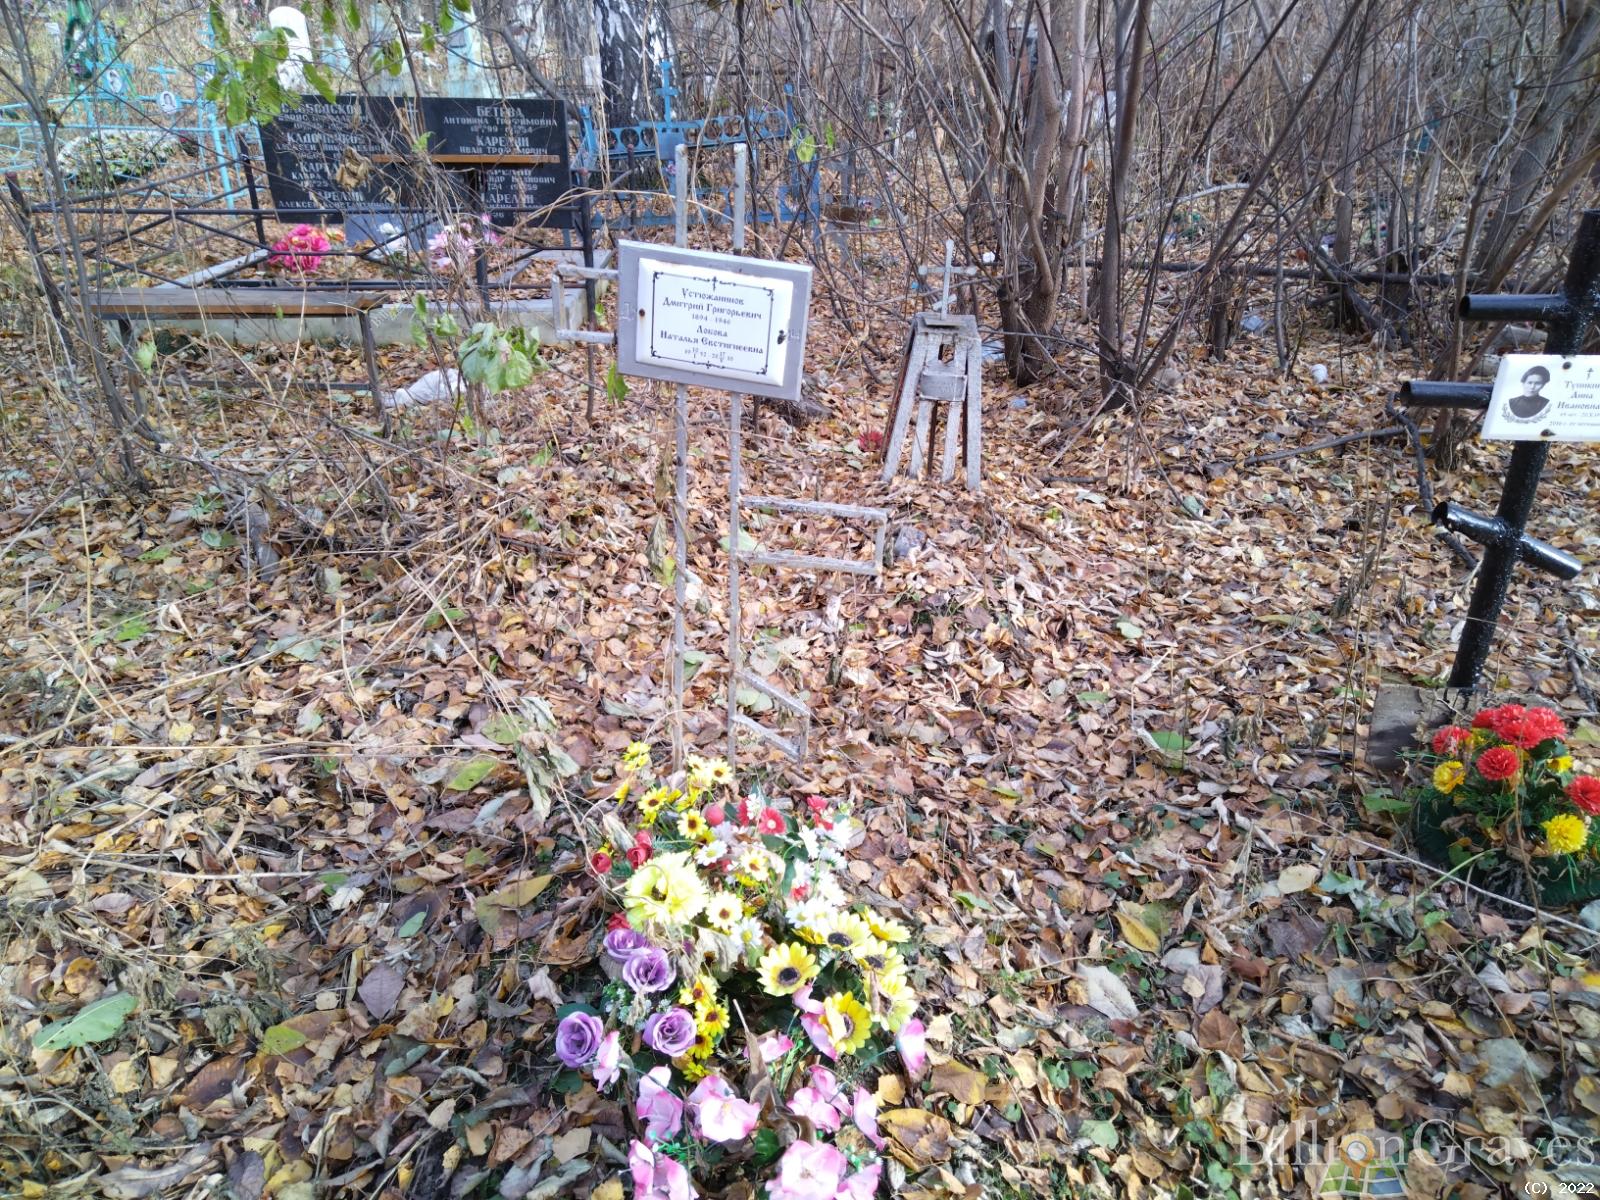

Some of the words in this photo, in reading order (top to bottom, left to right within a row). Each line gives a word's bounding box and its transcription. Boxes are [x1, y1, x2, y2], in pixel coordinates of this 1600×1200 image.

[496, 117, 558, 128] ТФИМОВНА
[476, 135, 530, 148] КАРЕИН
[487, 147, 548, 156] ТРОФМОВИЧ
[481, 192, 535, 204] АРЕЛН
[662, 296, 705, 312] Дмитрий
[706, 303, 763, 320] Григорьевич
[660, 330, 700, 345] Наталья
